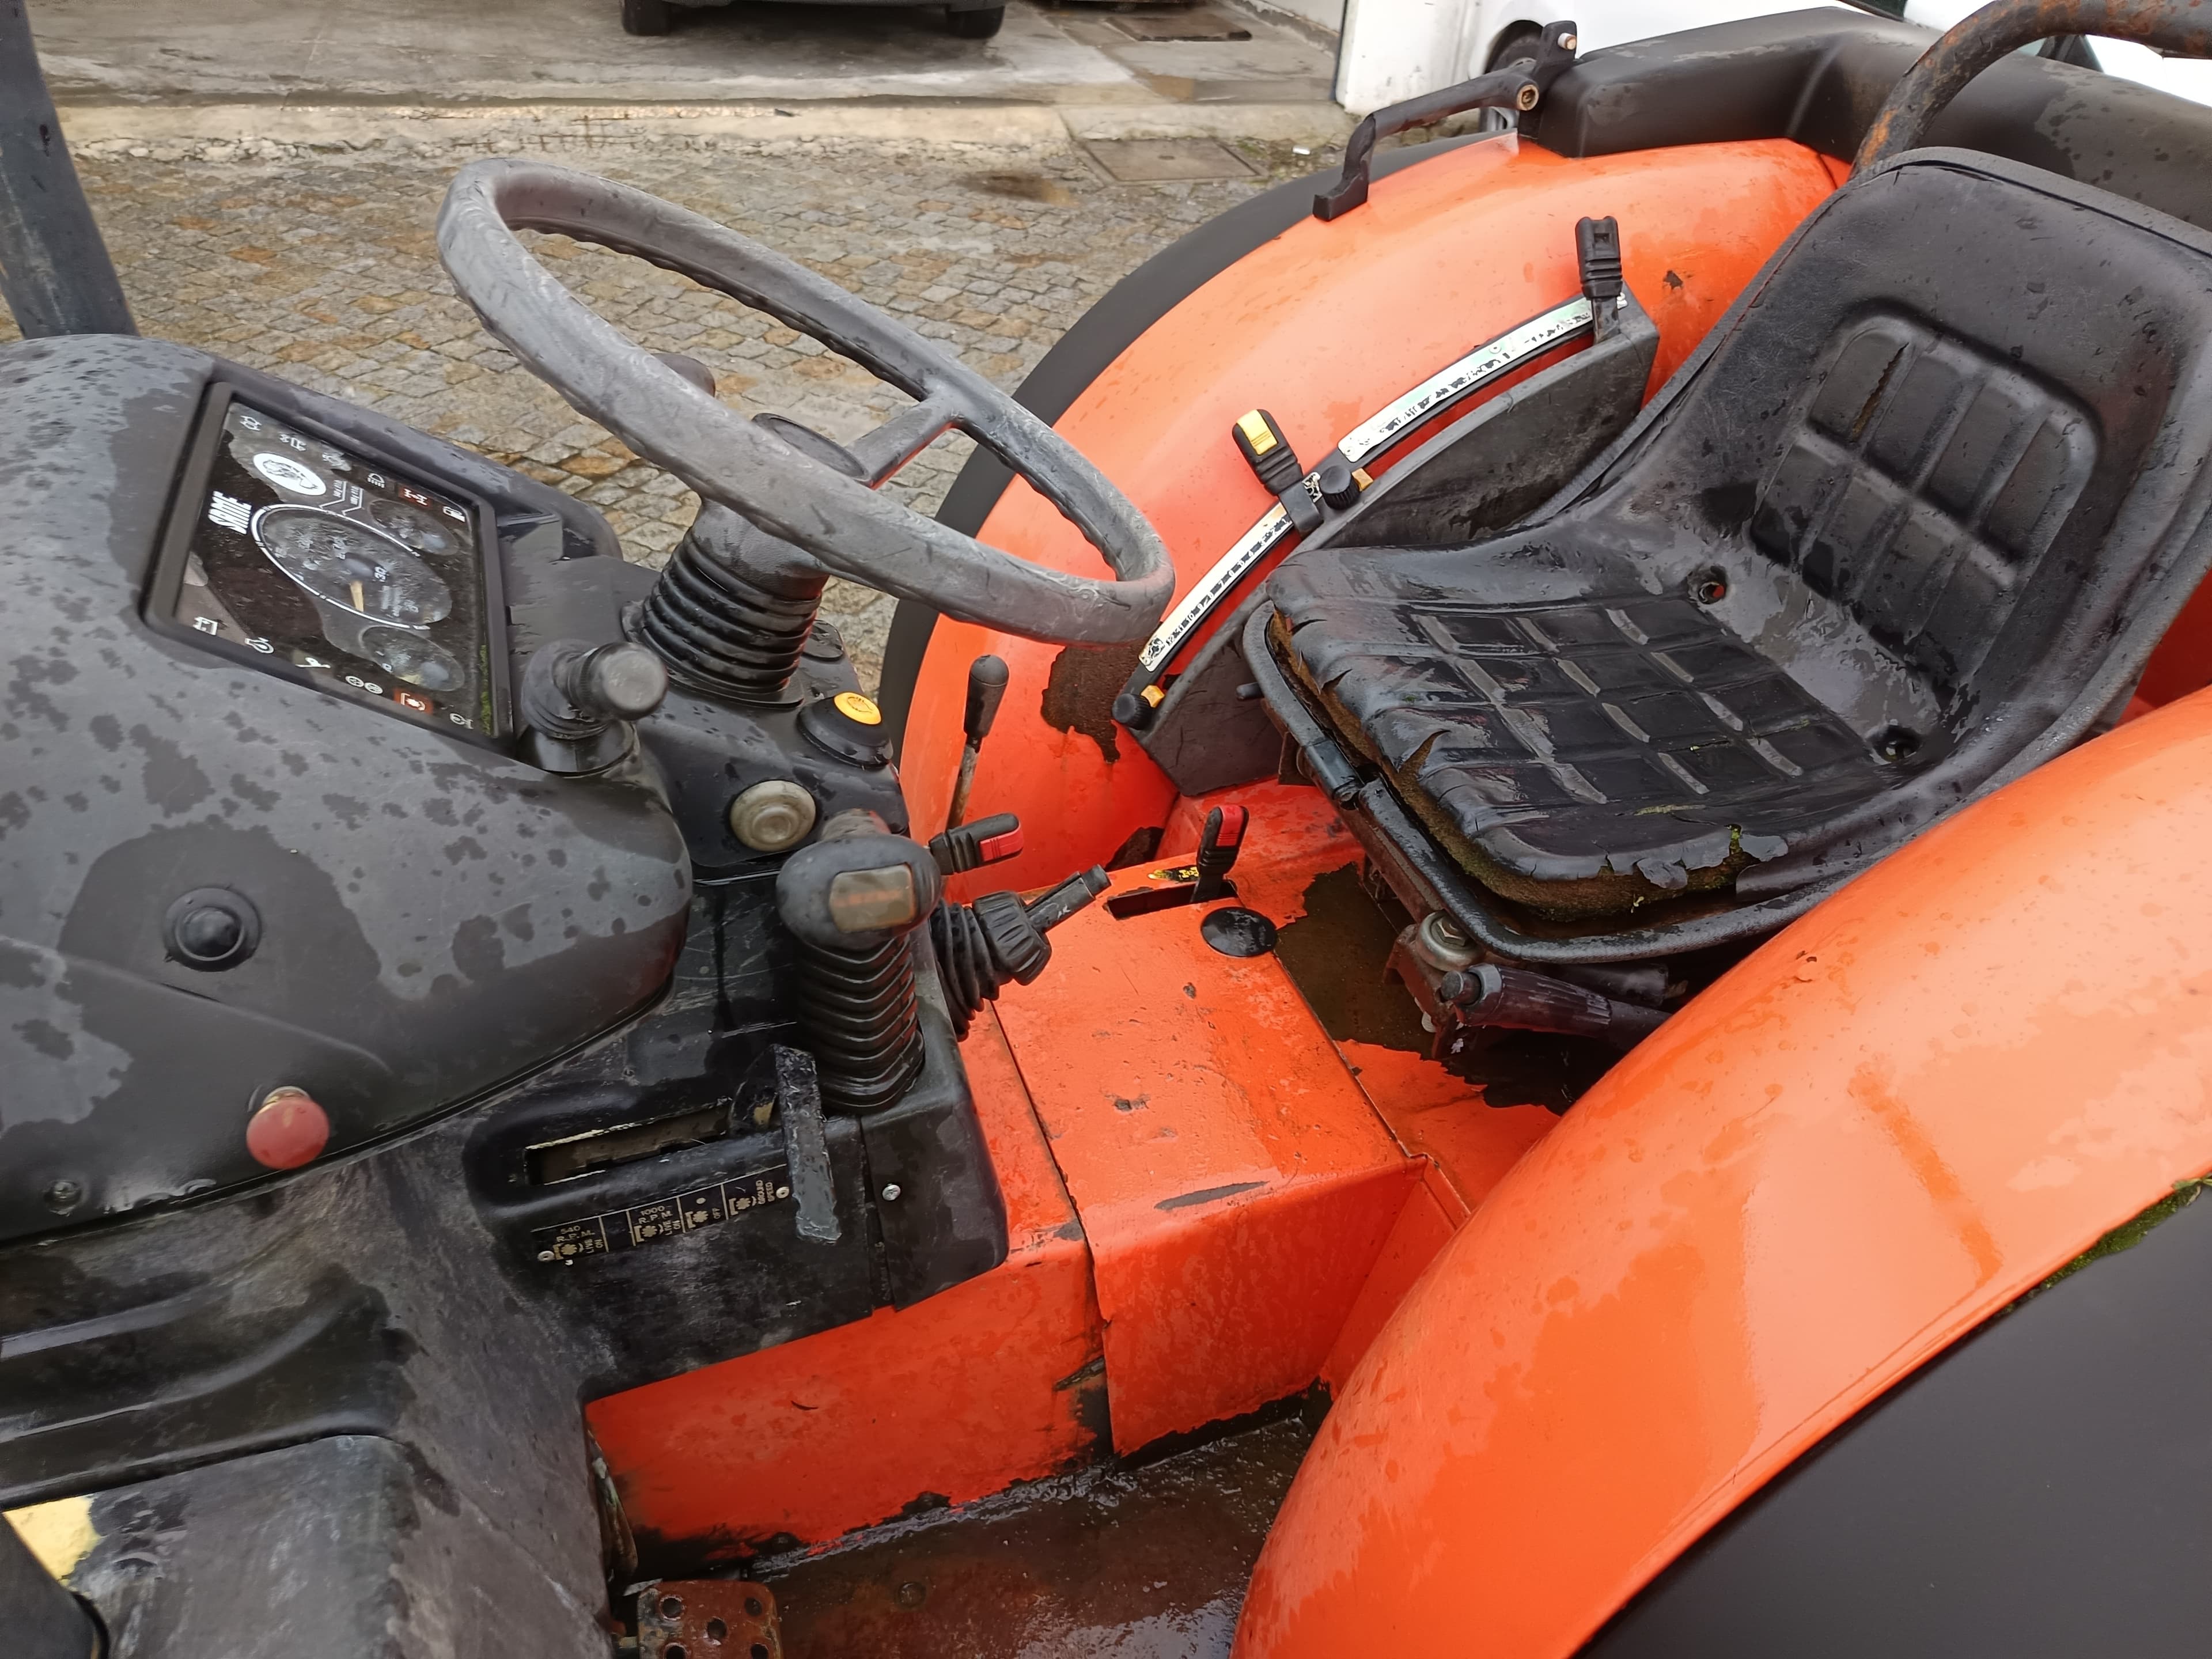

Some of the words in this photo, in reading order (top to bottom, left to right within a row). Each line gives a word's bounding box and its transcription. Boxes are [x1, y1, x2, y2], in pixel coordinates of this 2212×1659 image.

[207, 491, 252, 535] SAME
[755, 1180, 766, 1205] GROUND
[765, 1182, 775, 1202] SPEED
[641, 1206, 665, 1215] 1000
[712, 1207, 721, 1219] OFF
[560, 1225, 581, 1234] 540
[662, 1219, 673, 1236] LIVE
[672, 1219, 681, 1230] ON
[584, 1238, 594, 1254] LIVE
[594, 1238, 604, 1248] ON
